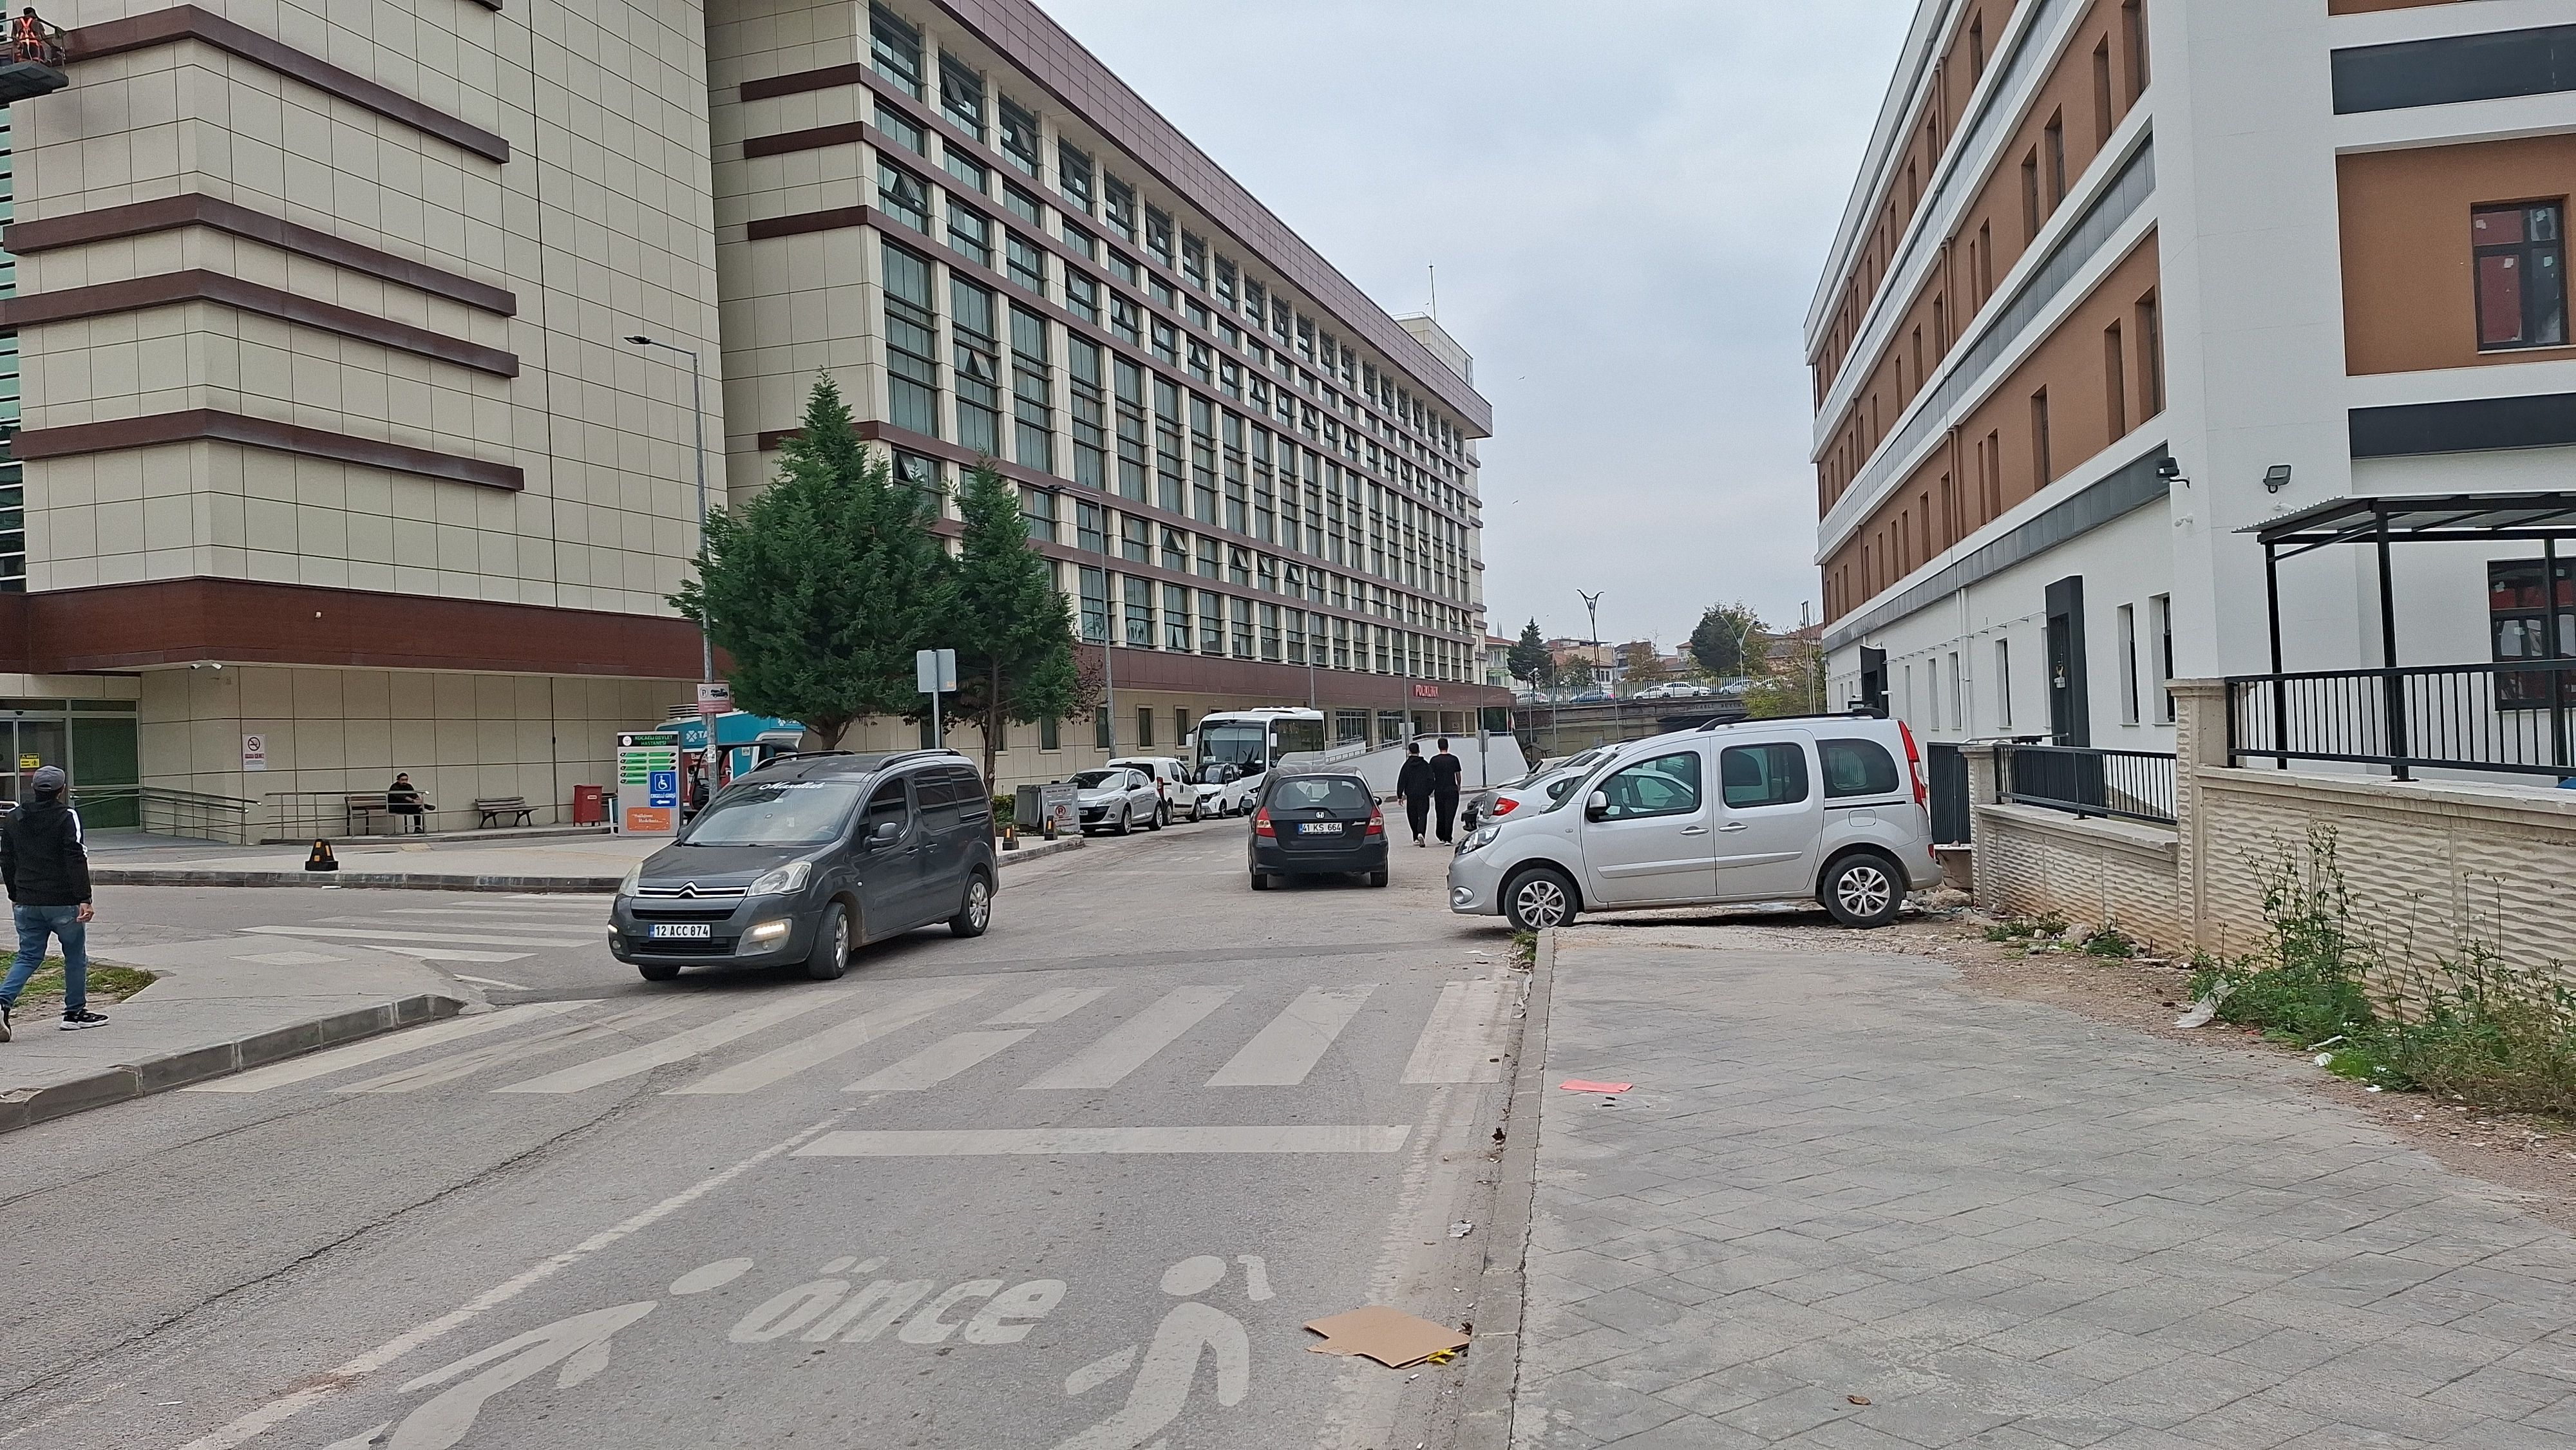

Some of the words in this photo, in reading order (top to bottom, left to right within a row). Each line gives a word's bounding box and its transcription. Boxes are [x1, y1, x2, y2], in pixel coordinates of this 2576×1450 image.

[656, 926, 667, 936] 12
[670, 926, 688, 936] ACC
[690, 926, 708, 936] 874
